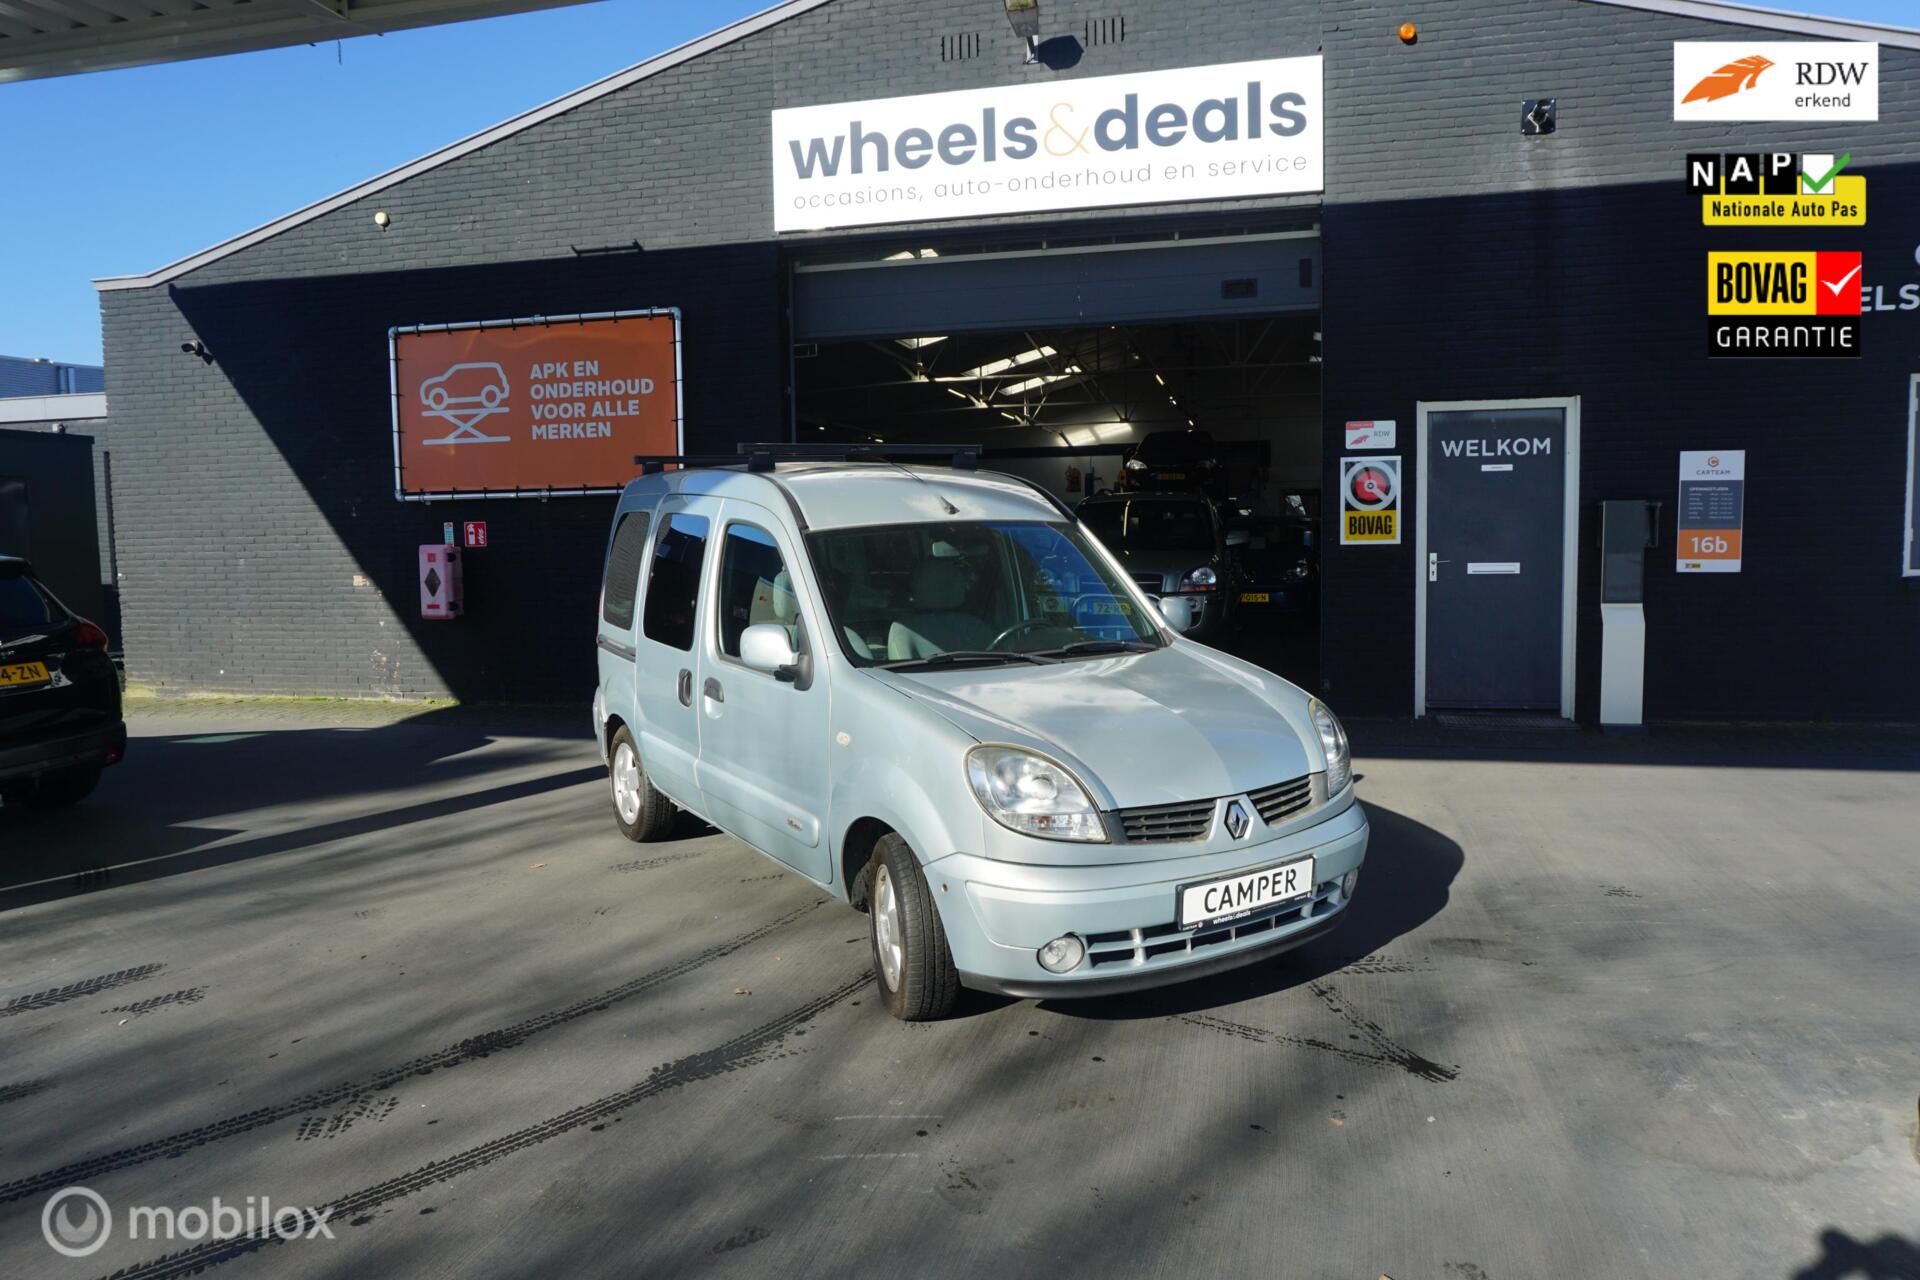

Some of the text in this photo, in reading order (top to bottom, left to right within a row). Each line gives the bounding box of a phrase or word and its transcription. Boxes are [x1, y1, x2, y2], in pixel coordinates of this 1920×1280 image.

[788, 80, 1308, 179] wheels&deals
[794, 153, 1308, 211] occasions, auto-onderhoud en service
[530, 360, 599, 379] APK EN
[530, 378, 654, 400] ONDERHOUD
[531, 399, 640, 419] VOOR ALLE
[531, 421, 611, 441] MERKEN
[1441, 437, 1551, 457] WELKOM
[1349, 514, 1393, 535] BOVAG
[1691, 536, 1728, 553] 16b
[1204, 868, 1297, 913] CAMPER
